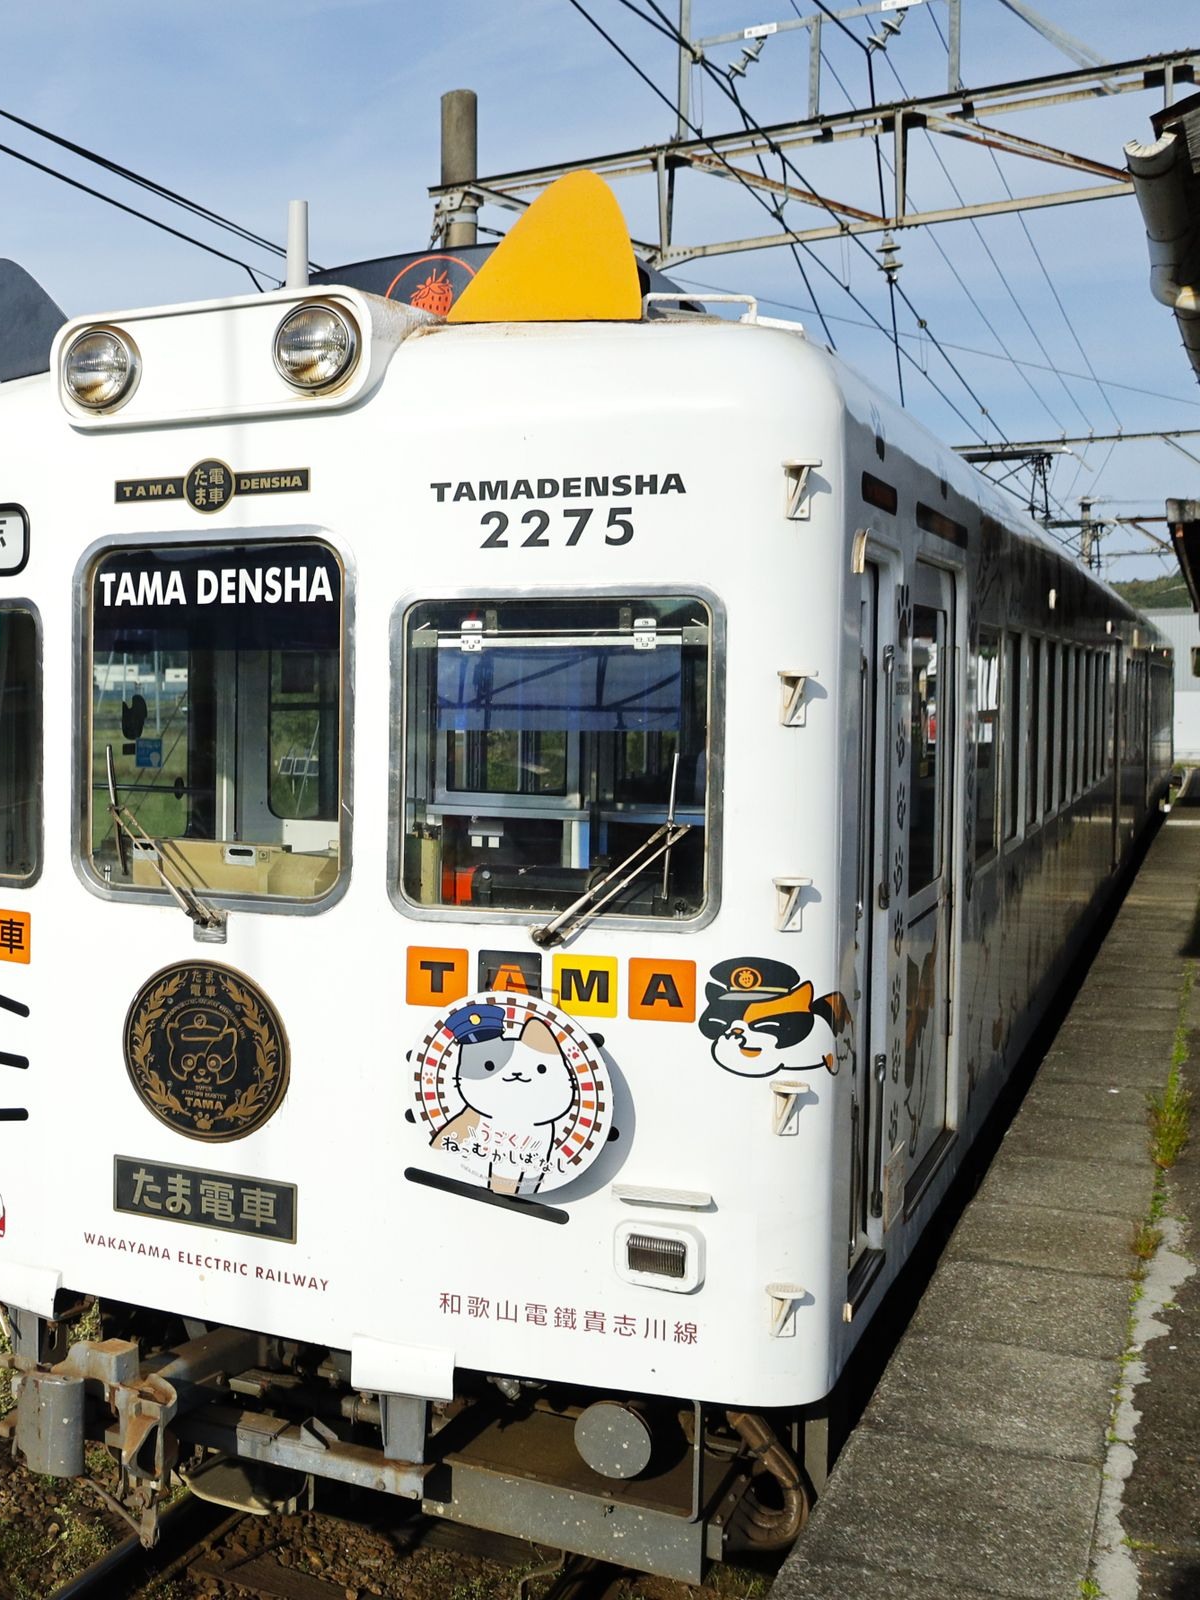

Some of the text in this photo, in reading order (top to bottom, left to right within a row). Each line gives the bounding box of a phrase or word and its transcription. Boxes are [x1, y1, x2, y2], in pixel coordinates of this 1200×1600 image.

[123, 483, 176, 497] TAMA
[240, 475, 303, 490] DENSHA
[430, 473, 687, 502] TAMADENSHA
[479, 506, 634, 549] 2275
[100, 566, 333, 607] TAMA DENSHA
[420, 961, 685, 1008] TAMA
[184, 1097, 224, 1111] TAMA
[132, 1168, 277, 1228] たま電車
[84, 1231, 329, 1292] WAKAYAMA ELECTRIC RAILWAY
[439, 1292, 698, 1345] 和歌山電鐵貴志川線
